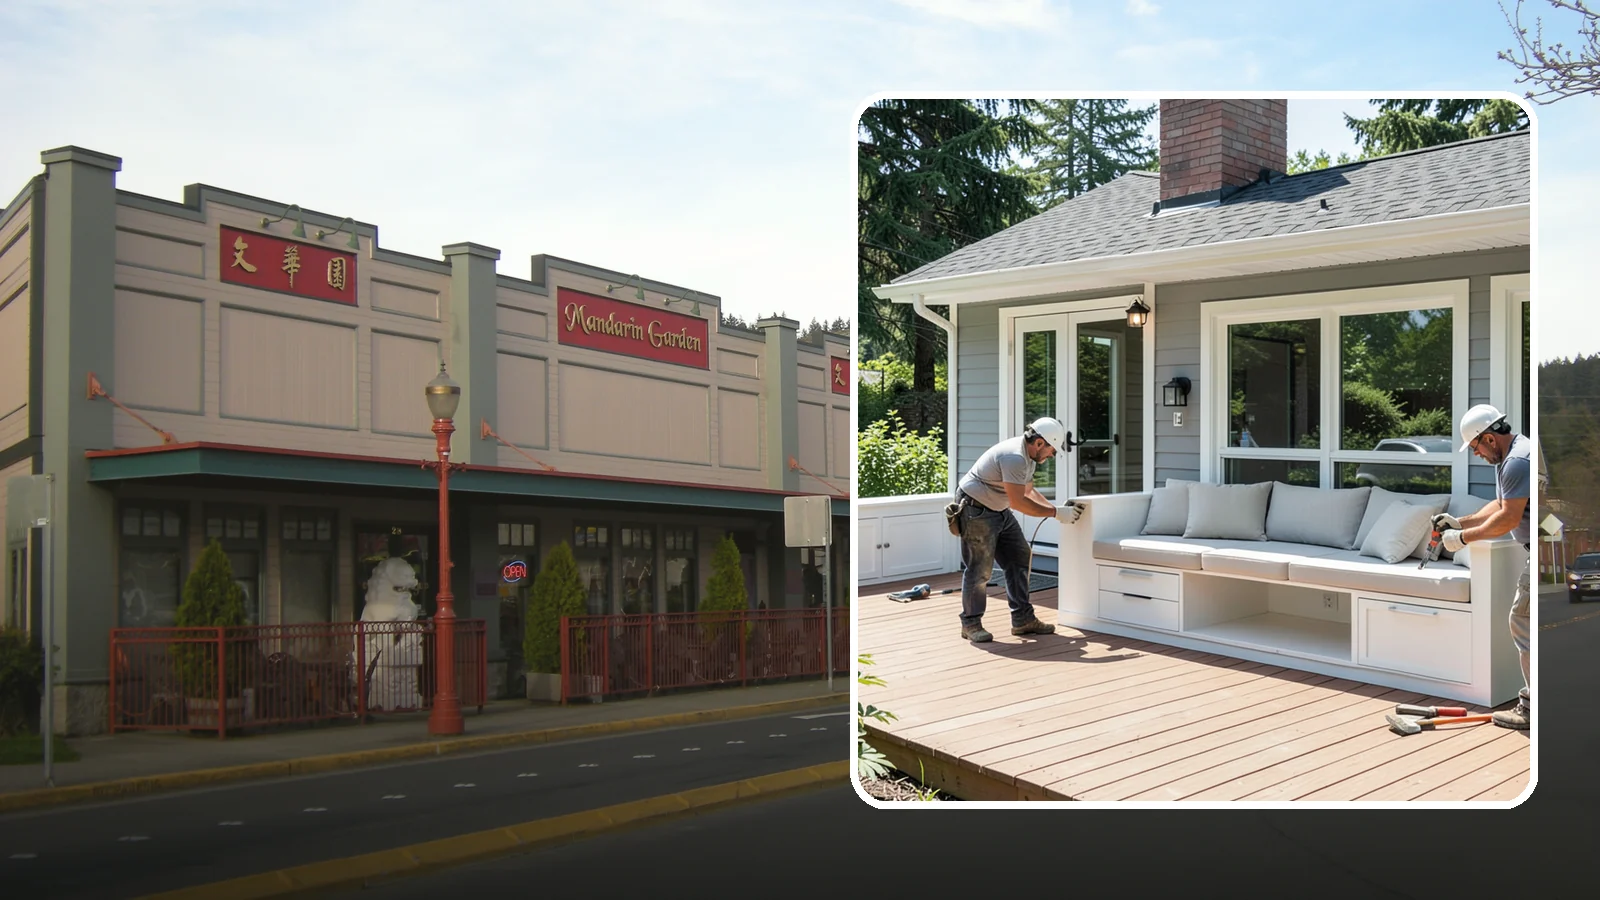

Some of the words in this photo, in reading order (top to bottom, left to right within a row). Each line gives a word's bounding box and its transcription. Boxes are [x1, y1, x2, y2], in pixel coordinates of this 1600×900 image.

[230, 235, 347, 291] 文華園
[564, 302, 645, 341] Mandarin
[647, 320, 702, 352] Garden
[503, 565, 527, 578] OPEN
